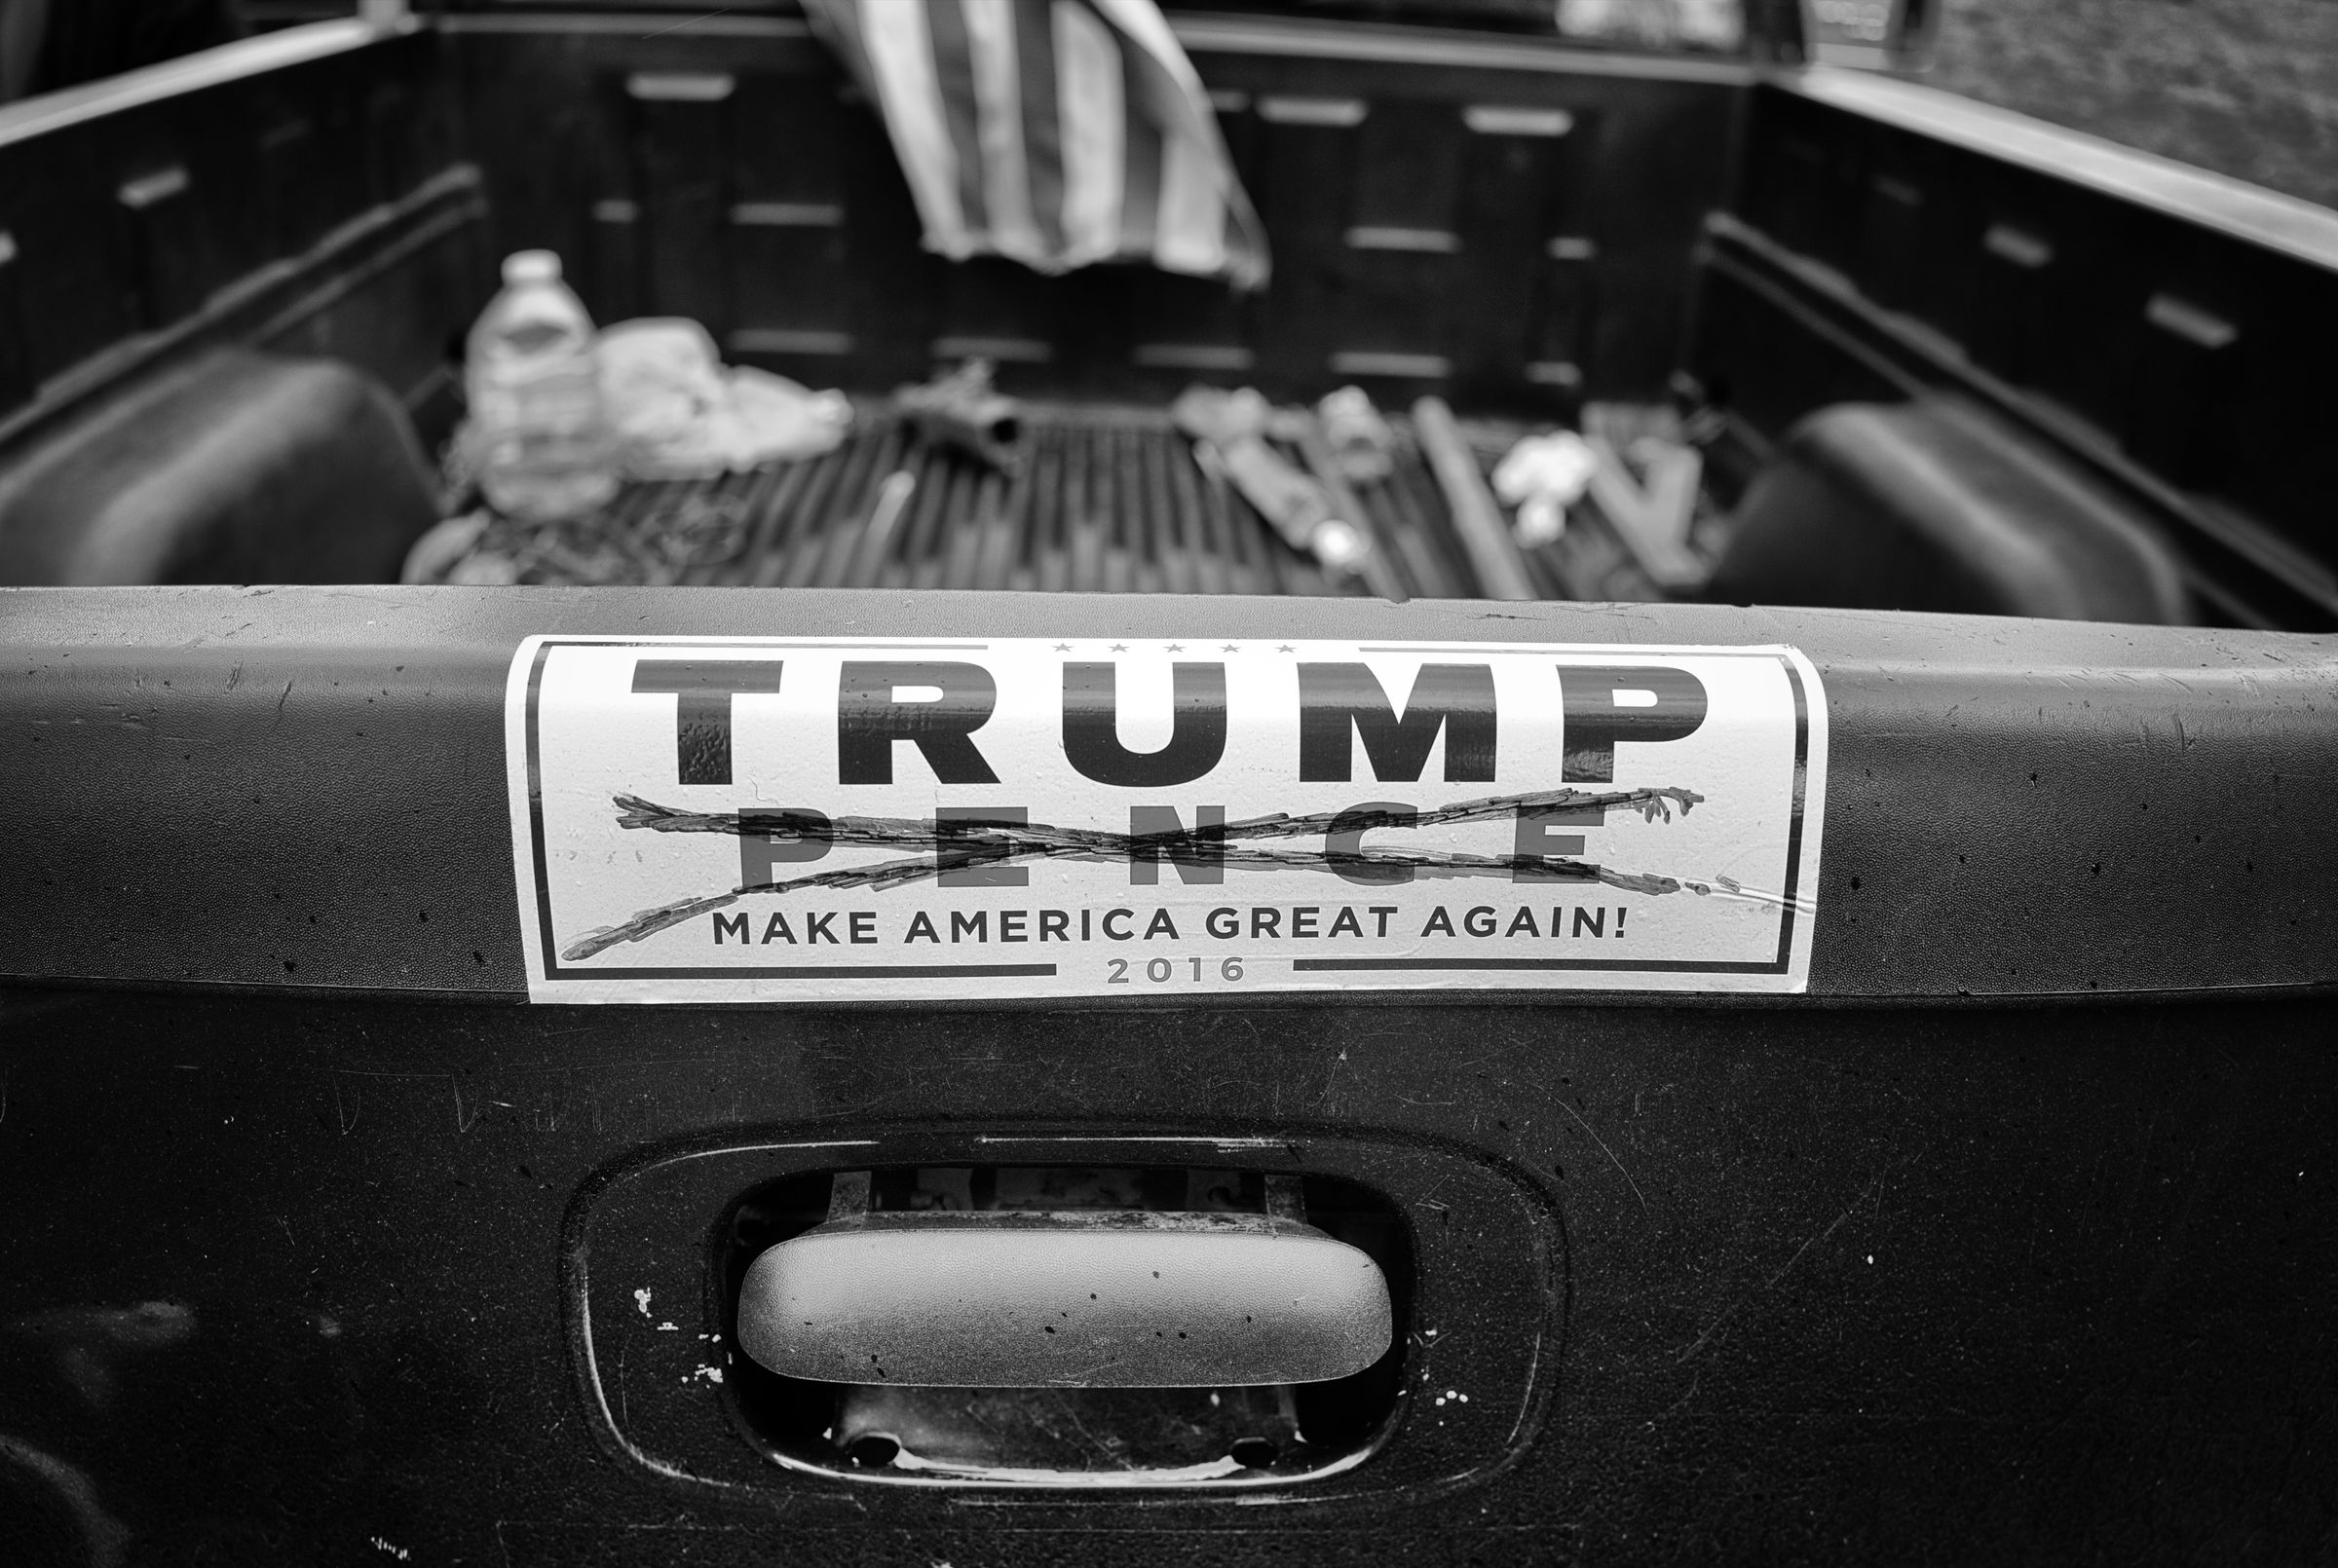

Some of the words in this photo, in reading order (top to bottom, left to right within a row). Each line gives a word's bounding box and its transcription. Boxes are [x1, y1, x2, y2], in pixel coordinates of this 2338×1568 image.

[631, 659, 1708, 786] TRUMP
[737, 802, 1604, 887] PENCE
[713, 911, 878, 945] MAKE
[904, 907, 1180, 943] AMERICA
[1205, 906, 1398, 939] GREAT
[1420, 906, 1629, 939] AGAIN!
[1107, 957, 1245, 984] 2016
